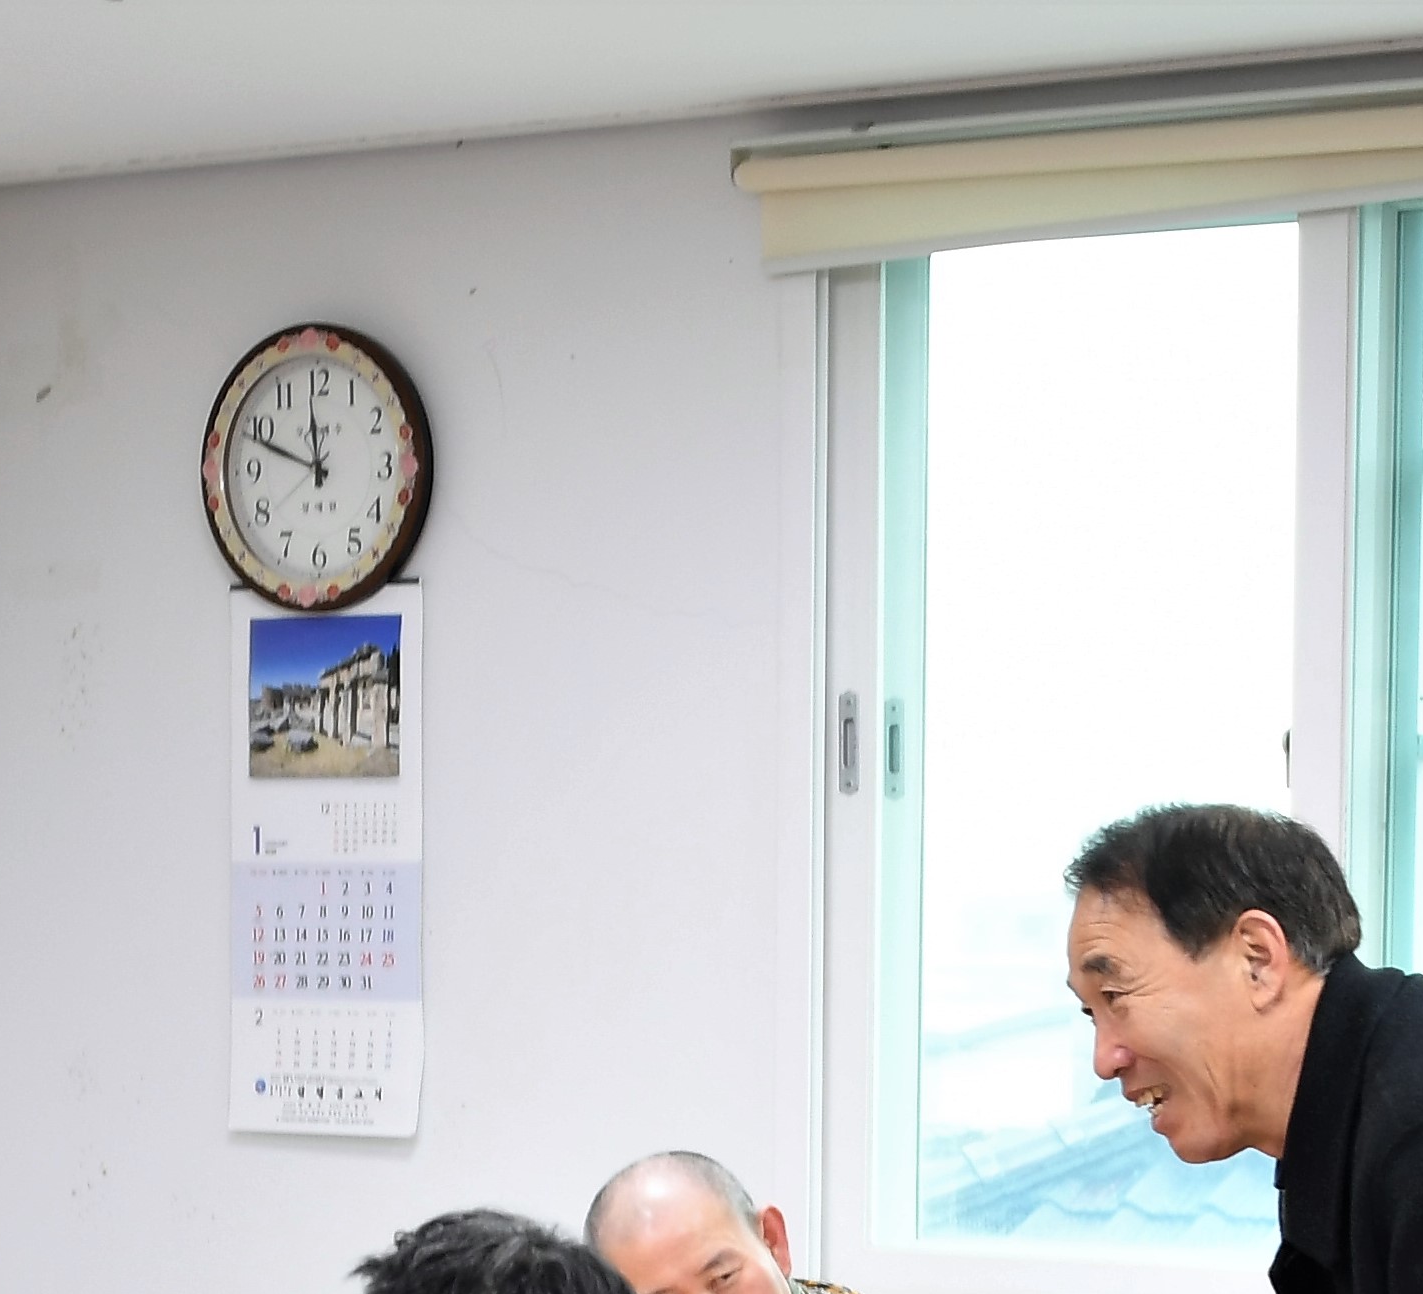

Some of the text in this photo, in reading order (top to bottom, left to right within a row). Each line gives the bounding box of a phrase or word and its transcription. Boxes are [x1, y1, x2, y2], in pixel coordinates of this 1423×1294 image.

[276, 382, 292, 410] 11
[309, 368, 330, 397] 12
[349, 379, 355, 407] 1
[252, 416, 275, 442] 10
[370, 406, 383, 435] 2
[246, 459, 262, 484] 9
[377, 451, 393, 481] 3
[254, 498, 271, 527] 8
[366, 496, 382, 524] 4
[279, 531, 293, 558] 7
[346, 527, 362, 556] 5
[312, 542, 327, 570] 6
[252, 825, 262, 855] 1
[321, 881, 393, 895] 1 2 3 4
[275, 905, 284, 919] 6
[298, 905, 305, 919] 7
[319, 905, 327, 919] 8
[341, 905, 349, 919] 9
[361, 905, 374, 919] 10
[383, 905, 394, 919] 11
[253, 928, 394, 943] 12 13 14 15 16 17 18
[253, 951, 395, 967] 19 20 21 22 23 24 25
[253, 974, 265, 990] 26
[295, 974, 308, 990] 28
[317, 974, 329, 990] 29
[338, 974, 351, 990] 30
[360, 974, 372, 990] 31
[255, 1009, 263, 1026] 2
